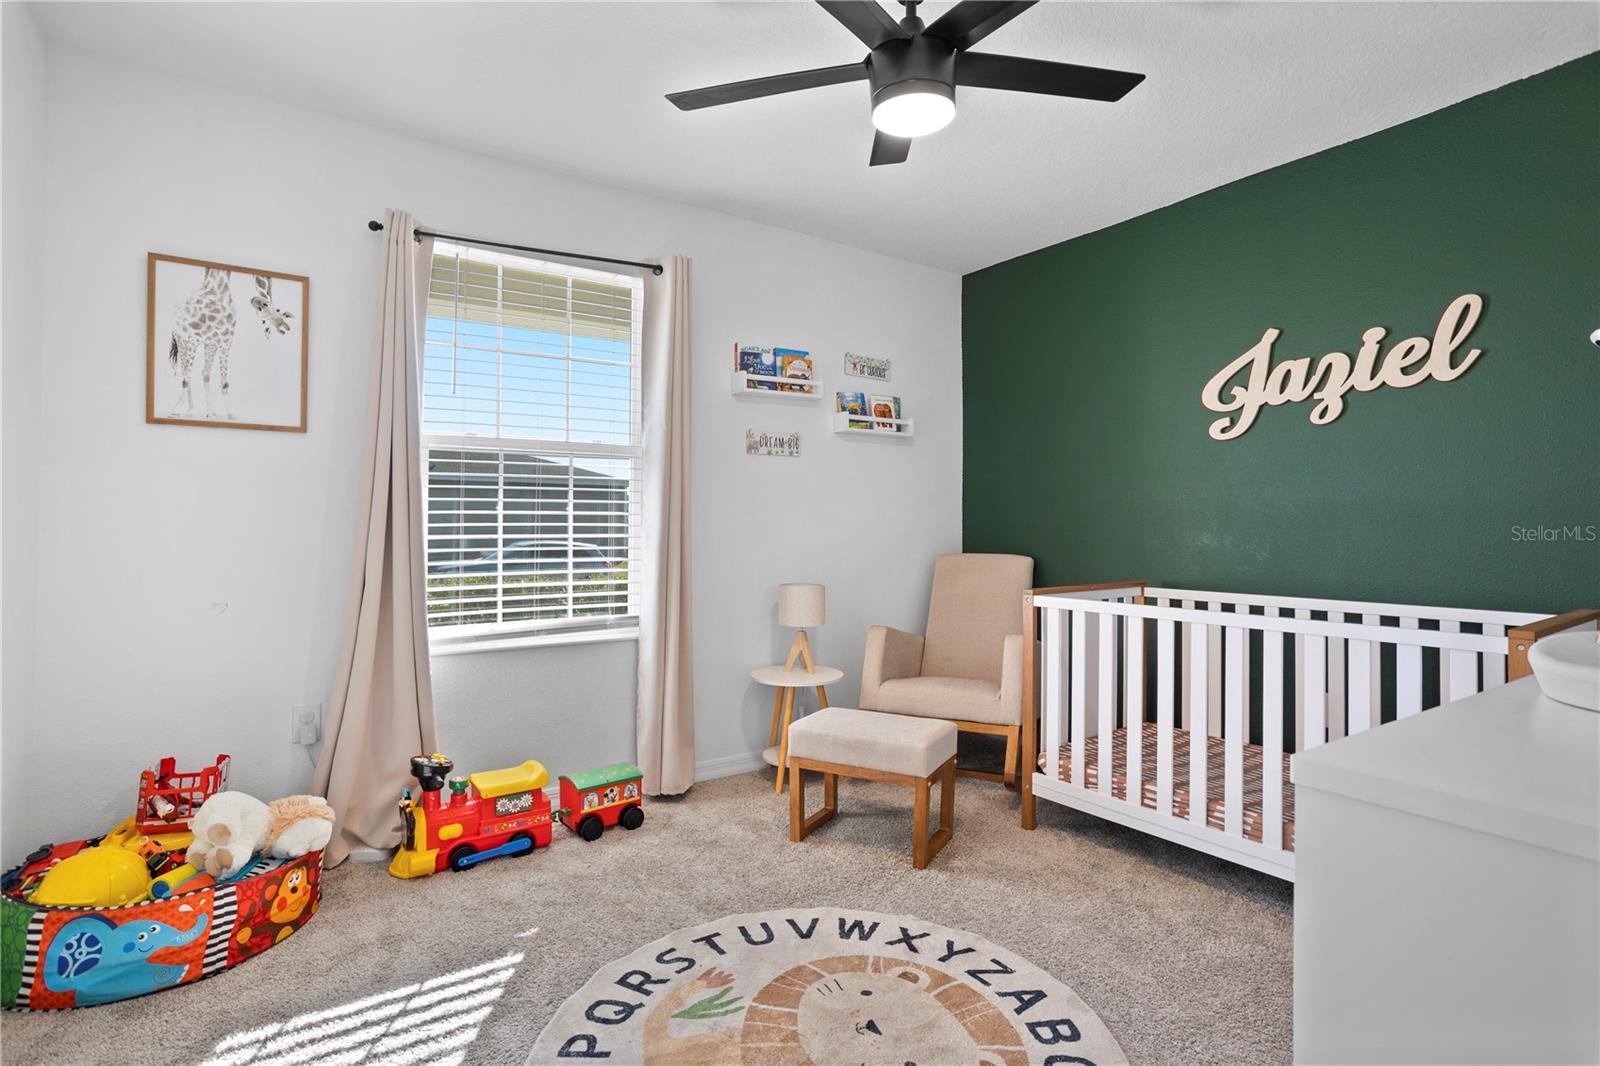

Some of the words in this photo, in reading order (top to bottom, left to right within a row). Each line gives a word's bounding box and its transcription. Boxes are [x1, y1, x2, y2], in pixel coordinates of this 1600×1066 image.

[859, 363, 866, 375] BE
[1200, 293, 1484, 440] Jaziel
[759, 435, 785, 449] DREAM
[787, 437, 800, 450] BIG
